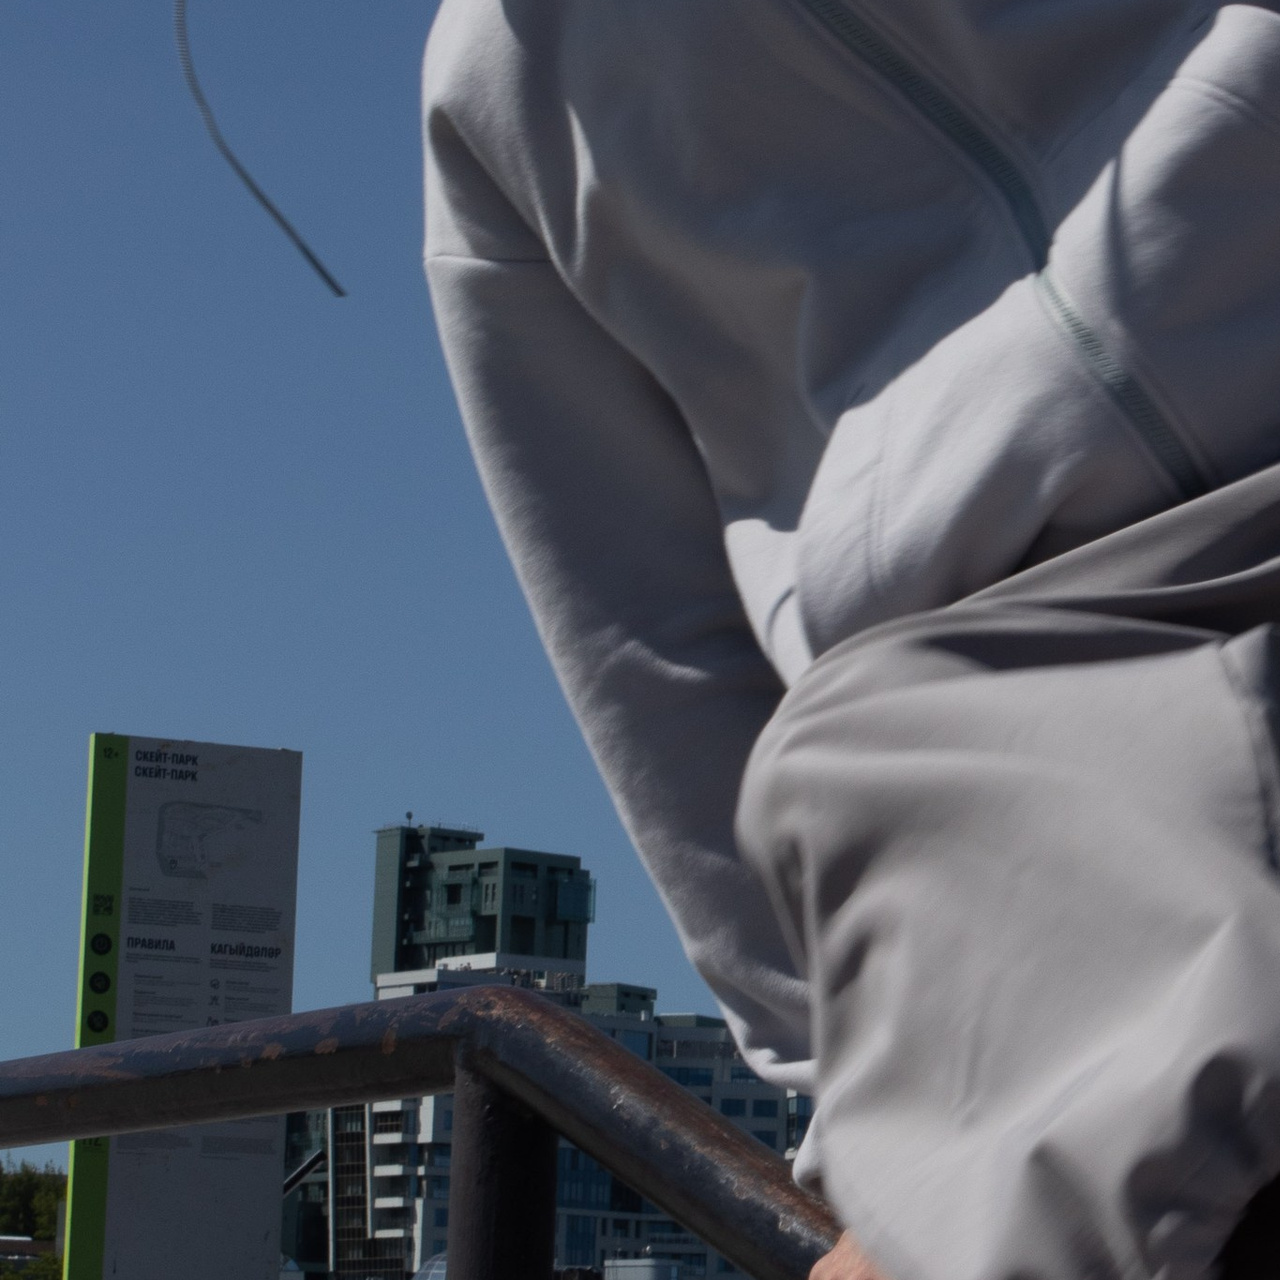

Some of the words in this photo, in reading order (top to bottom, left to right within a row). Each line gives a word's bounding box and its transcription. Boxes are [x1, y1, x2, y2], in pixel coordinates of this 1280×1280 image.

[135, 748, 199, 766] СКЕЙТ-ПАРК
[134, 764, 198, 781] СКЕЙТ-ПАРК
[127, 936, 176, 951] ПРАВИЛА
